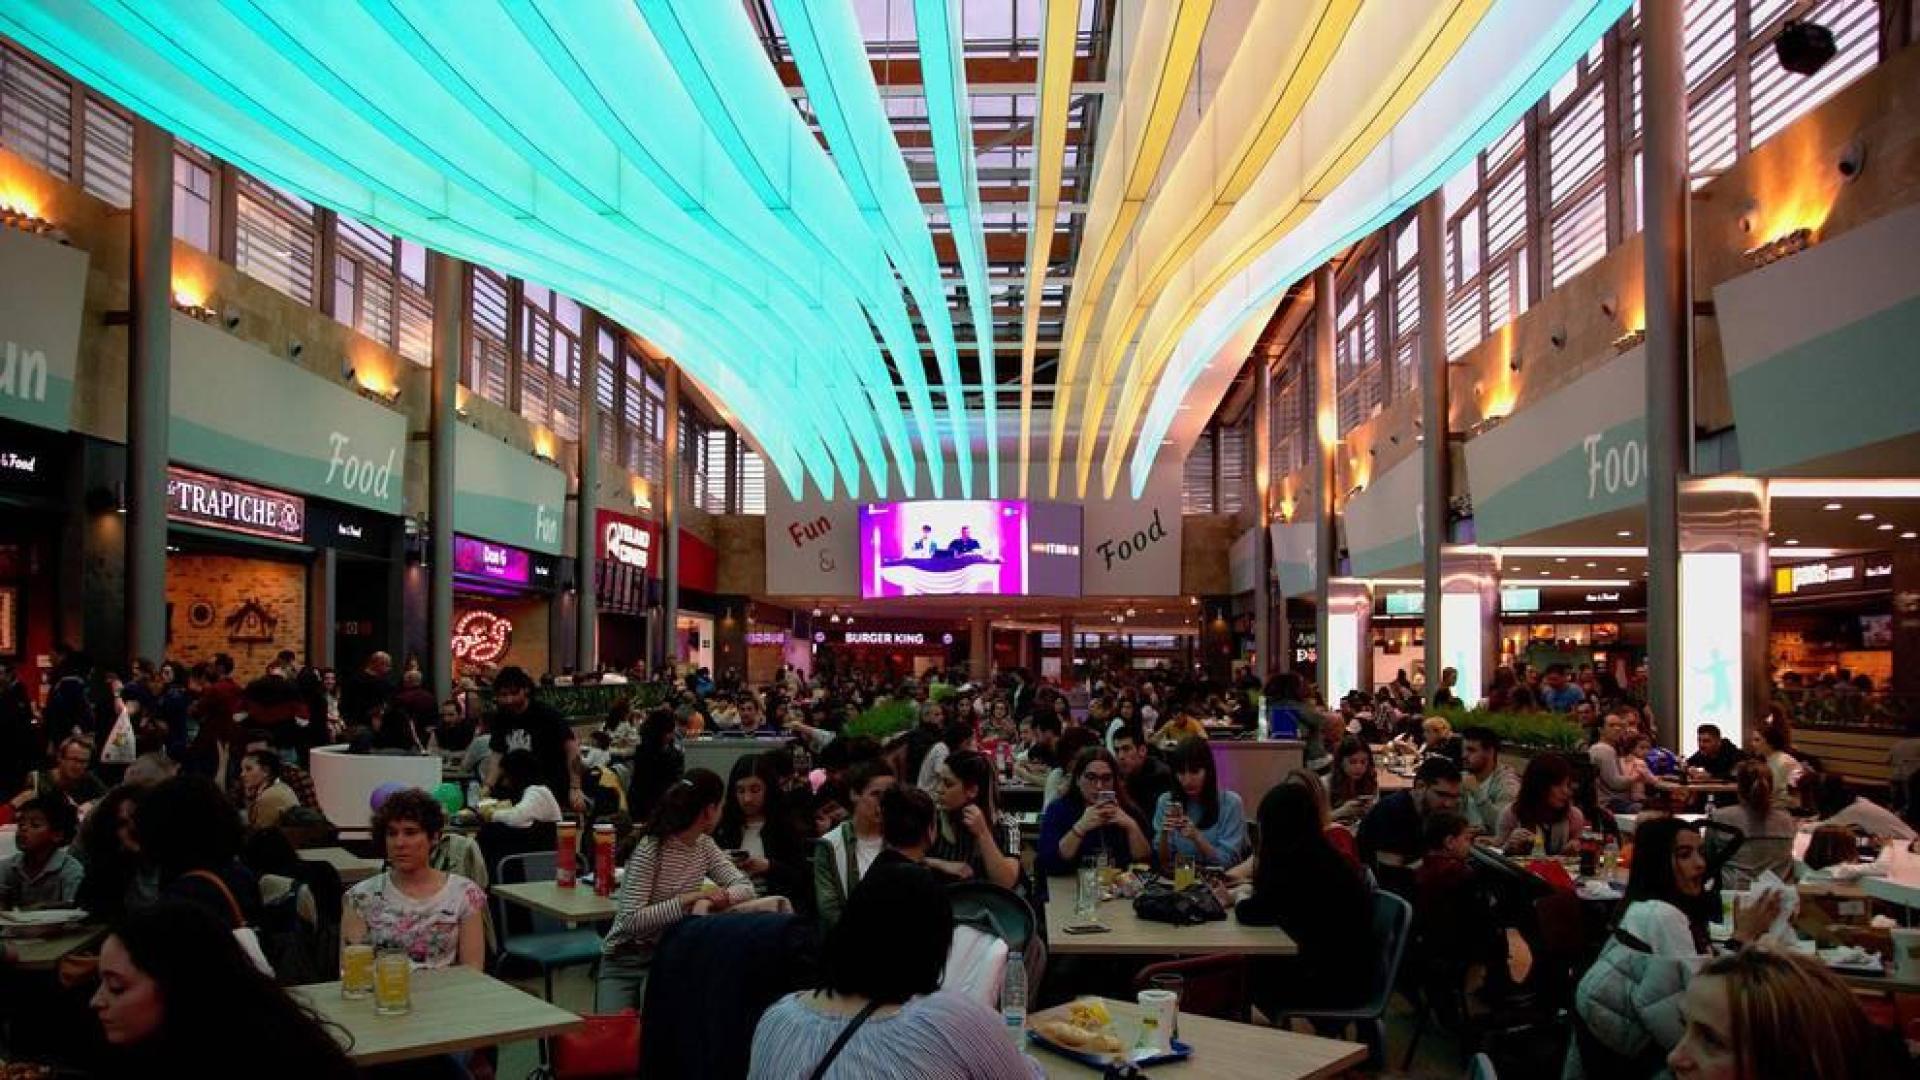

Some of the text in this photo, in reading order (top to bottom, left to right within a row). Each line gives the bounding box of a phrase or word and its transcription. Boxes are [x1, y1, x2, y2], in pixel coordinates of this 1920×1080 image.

[0, 341, 47, 401] un
[325, 431, 395, 498] Food
[1584, 433, 1648, 498] Foo
[177, 481, 277, 527] TRAPICHE
[788, 515, 833, 548] Fun
[1095, 508, 1168, 571] Food
[819, 549, 837, 572] &
[845, 632, 924, 645] BURGER KING
